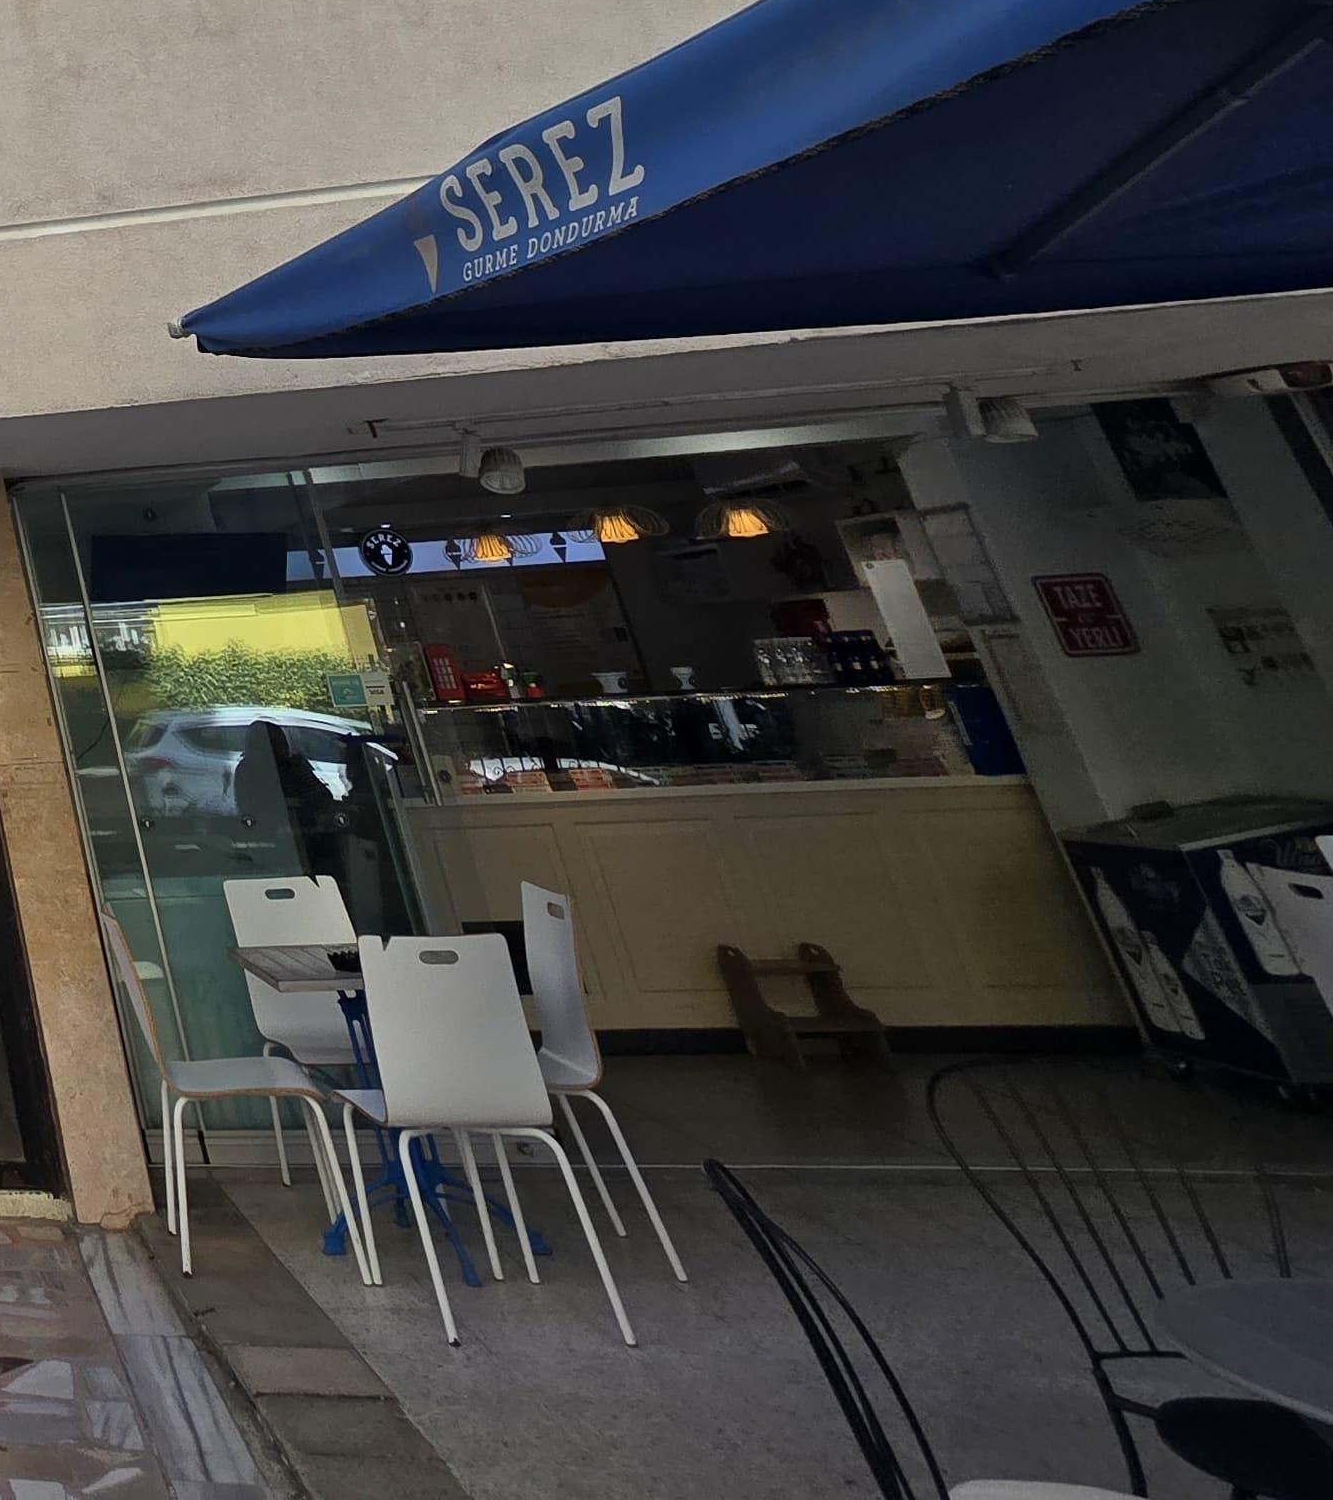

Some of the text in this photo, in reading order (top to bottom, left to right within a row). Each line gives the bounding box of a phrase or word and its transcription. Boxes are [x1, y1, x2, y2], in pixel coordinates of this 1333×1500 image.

[439, 96, 645, 253] SEREZ
[462, 197, 638, 282] GURME DONDURMA
